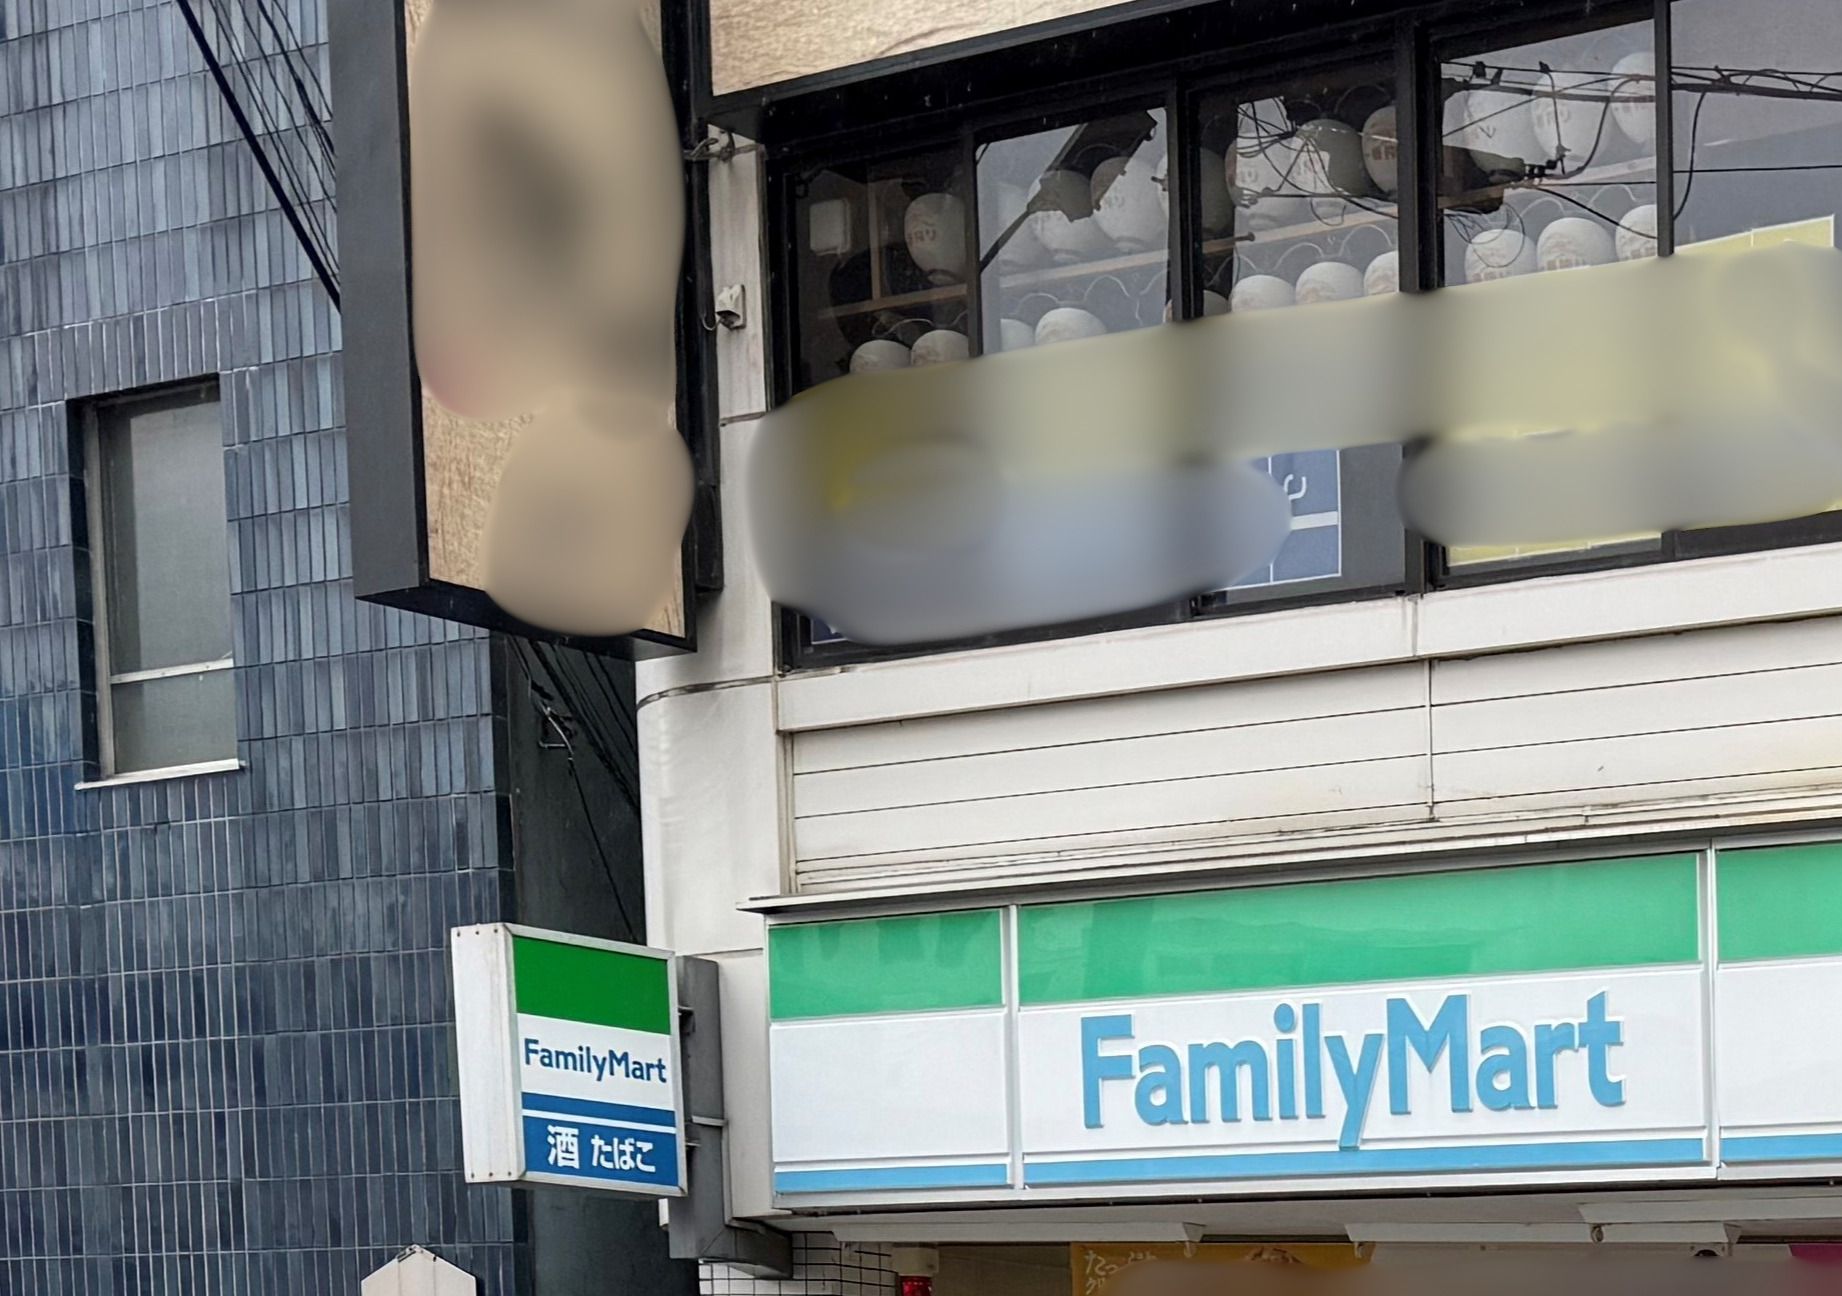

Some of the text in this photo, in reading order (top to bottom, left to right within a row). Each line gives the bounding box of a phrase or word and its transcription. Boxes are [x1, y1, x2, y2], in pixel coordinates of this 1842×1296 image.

[524, 1038, 667, 1083] FamilyMart
[1081, 991, 1625, 1150] FamilyMart
[547, 1125, 656, 1173] 酒 たばこ
